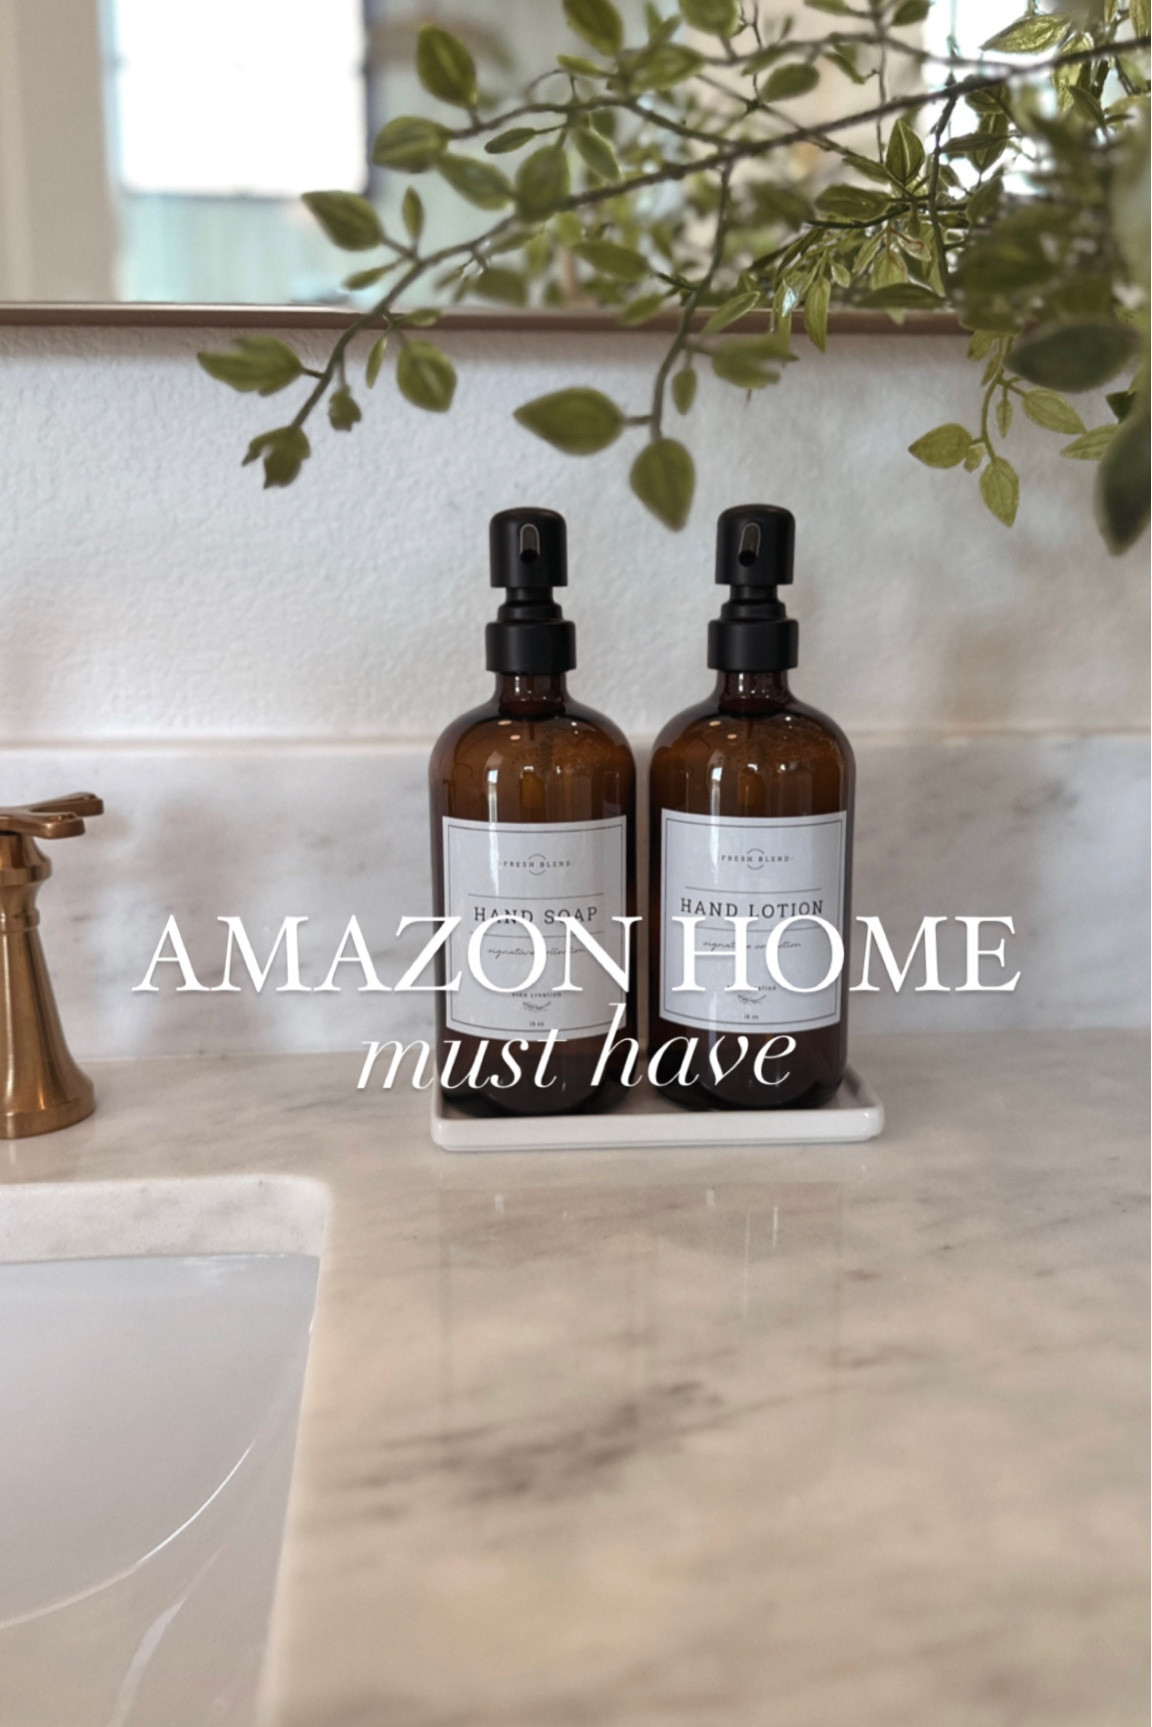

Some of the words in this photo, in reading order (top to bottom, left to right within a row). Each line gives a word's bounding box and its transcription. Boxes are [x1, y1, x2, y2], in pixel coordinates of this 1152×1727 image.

[503, 860, 535, 868] FRESH
[539, 860, 572, 868] BLEND
[721, 854, 753, 863] FRESH
[758, 854, 791, 863] BLEND
[680, 897, 739, 917] HAND
[748, 899, 824, 919] LOTION
[474, 906, 534, 924] HAND
[543, 906, 598, 924] SOAP
